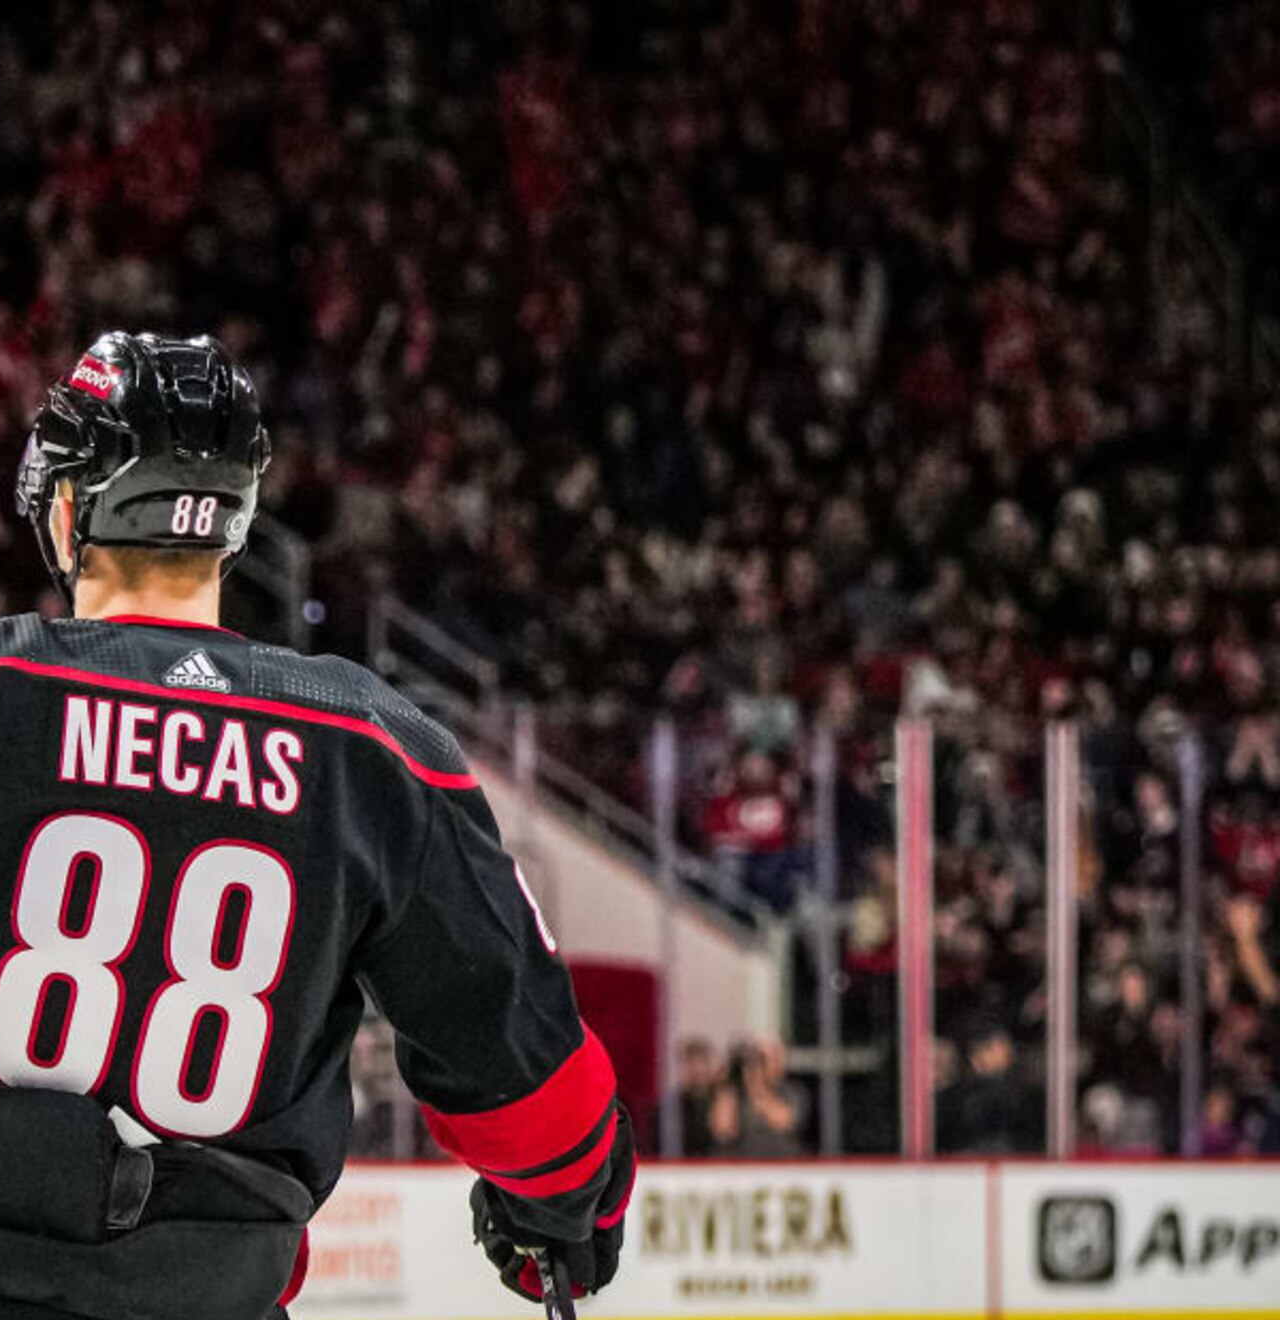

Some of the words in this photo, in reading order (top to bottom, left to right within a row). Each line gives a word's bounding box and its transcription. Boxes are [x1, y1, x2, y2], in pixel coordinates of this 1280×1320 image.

[171, 493, 217, 537] 88
[165, 674, 228, 690] adidas
[59, 694, 305, 815] NECAS
[642, 1184, 855, 1257] RIVIERA
